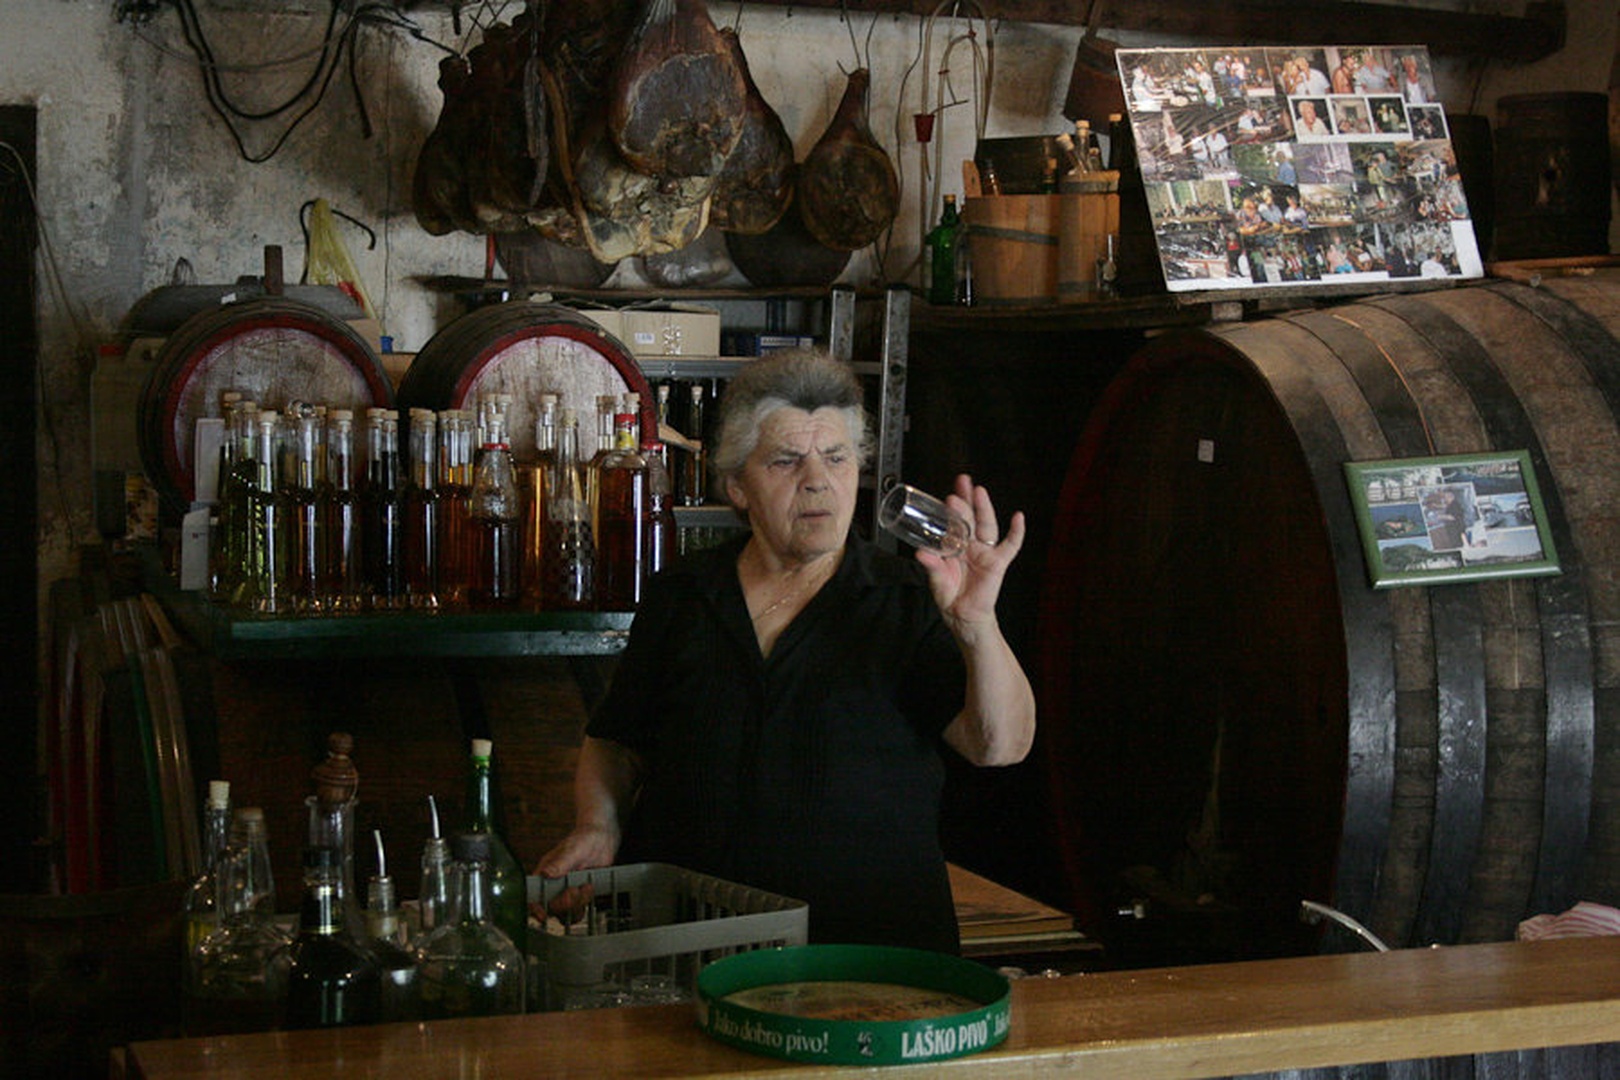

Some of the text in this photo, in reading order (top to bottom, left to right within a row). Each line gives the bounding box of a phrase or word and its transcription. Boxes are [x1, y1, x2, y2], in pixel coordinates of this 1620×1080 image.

[739, 1019, 783, 1048] dobro
[786, 1028, 829, 1056] pivo!
[901, 1024, 956, 1059] LAŠKO
[958, 1019, 988, 1052] PIVO
